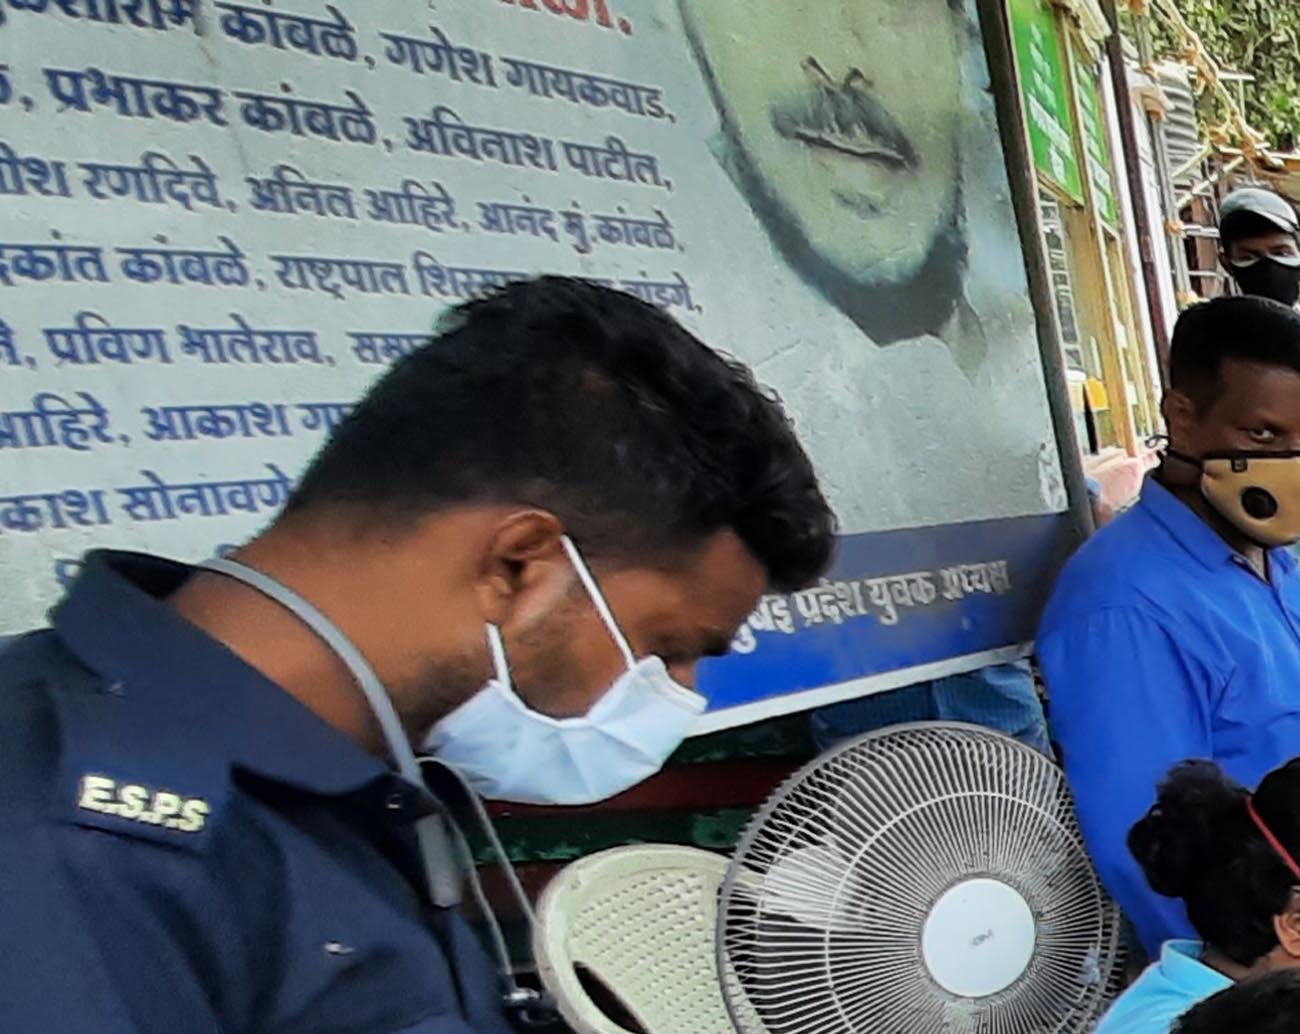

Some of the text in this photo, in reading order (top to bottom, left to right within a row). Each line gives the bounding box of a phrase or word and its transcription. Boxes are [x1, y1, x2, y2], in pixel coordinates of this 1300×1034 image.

[379, 26, 498, 88] गणेश
[501, 56, 676, 124] गायकवाड,
[42, 66, 229, 127] प्रभाकर
[403, 106, 558, 171] अविनाश
[76, 151, 239, 213] रणदिवे,
[42, 311, 173, 367] प्रविण
[141, 401, 293, 443] आकाश
